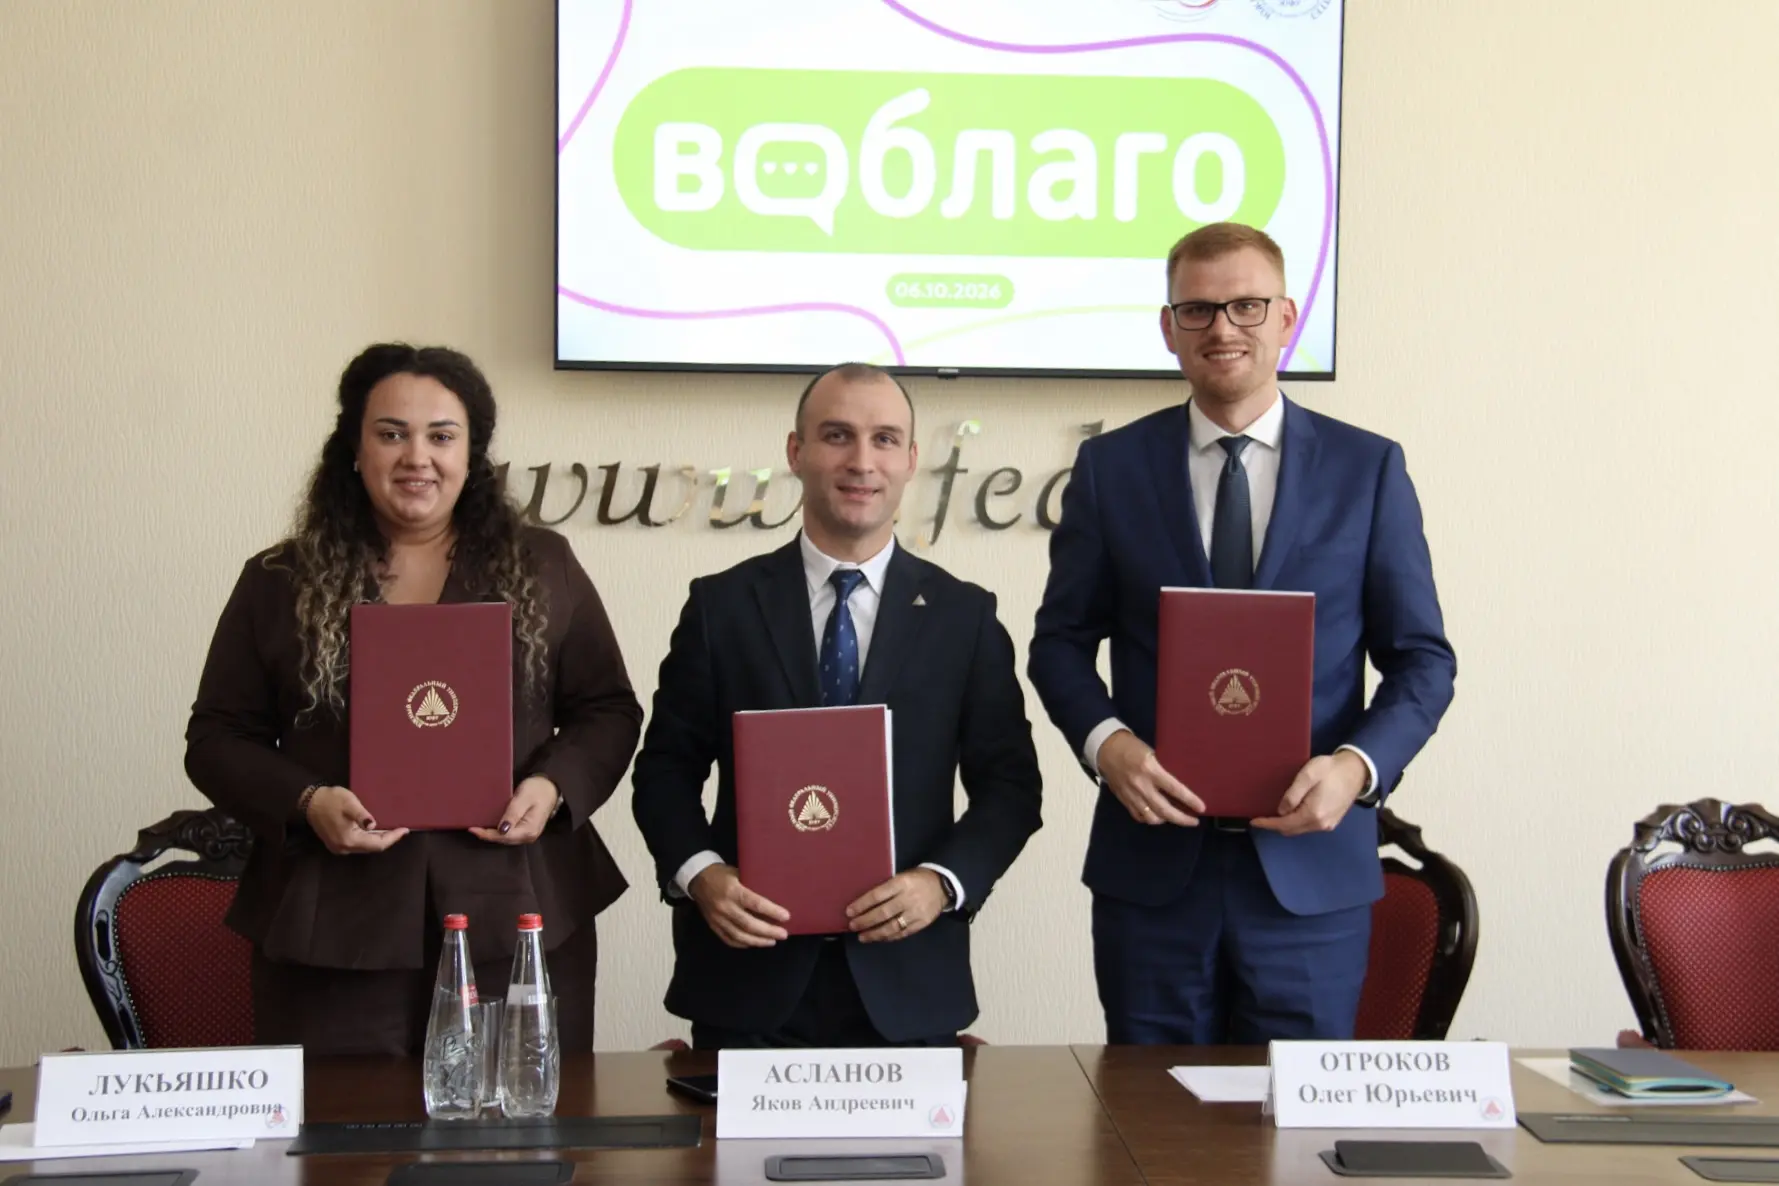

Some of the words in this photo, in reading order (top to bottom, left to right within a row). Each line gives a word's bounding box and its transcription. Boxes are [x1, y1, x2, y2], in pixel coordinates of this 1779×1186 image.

[1319, 1051, 1451, 1072] ОТРОКОВ
[88, 1068, 269, 1096] ЛУКЬЯШКО
[764, 1062, 904, 1084] АСЛАНОВ
[751, 1094, 802, 1112] Яков
[808, 1095, 915, 1115] Андреевич
[1298, 1083, 1358, 1104] Олег
[1365, 1082, 1477, 1107] Юрьевич
[71, 1106, 131, 1123] Ольга
[137, 1102, 282, 1121] Александровна
